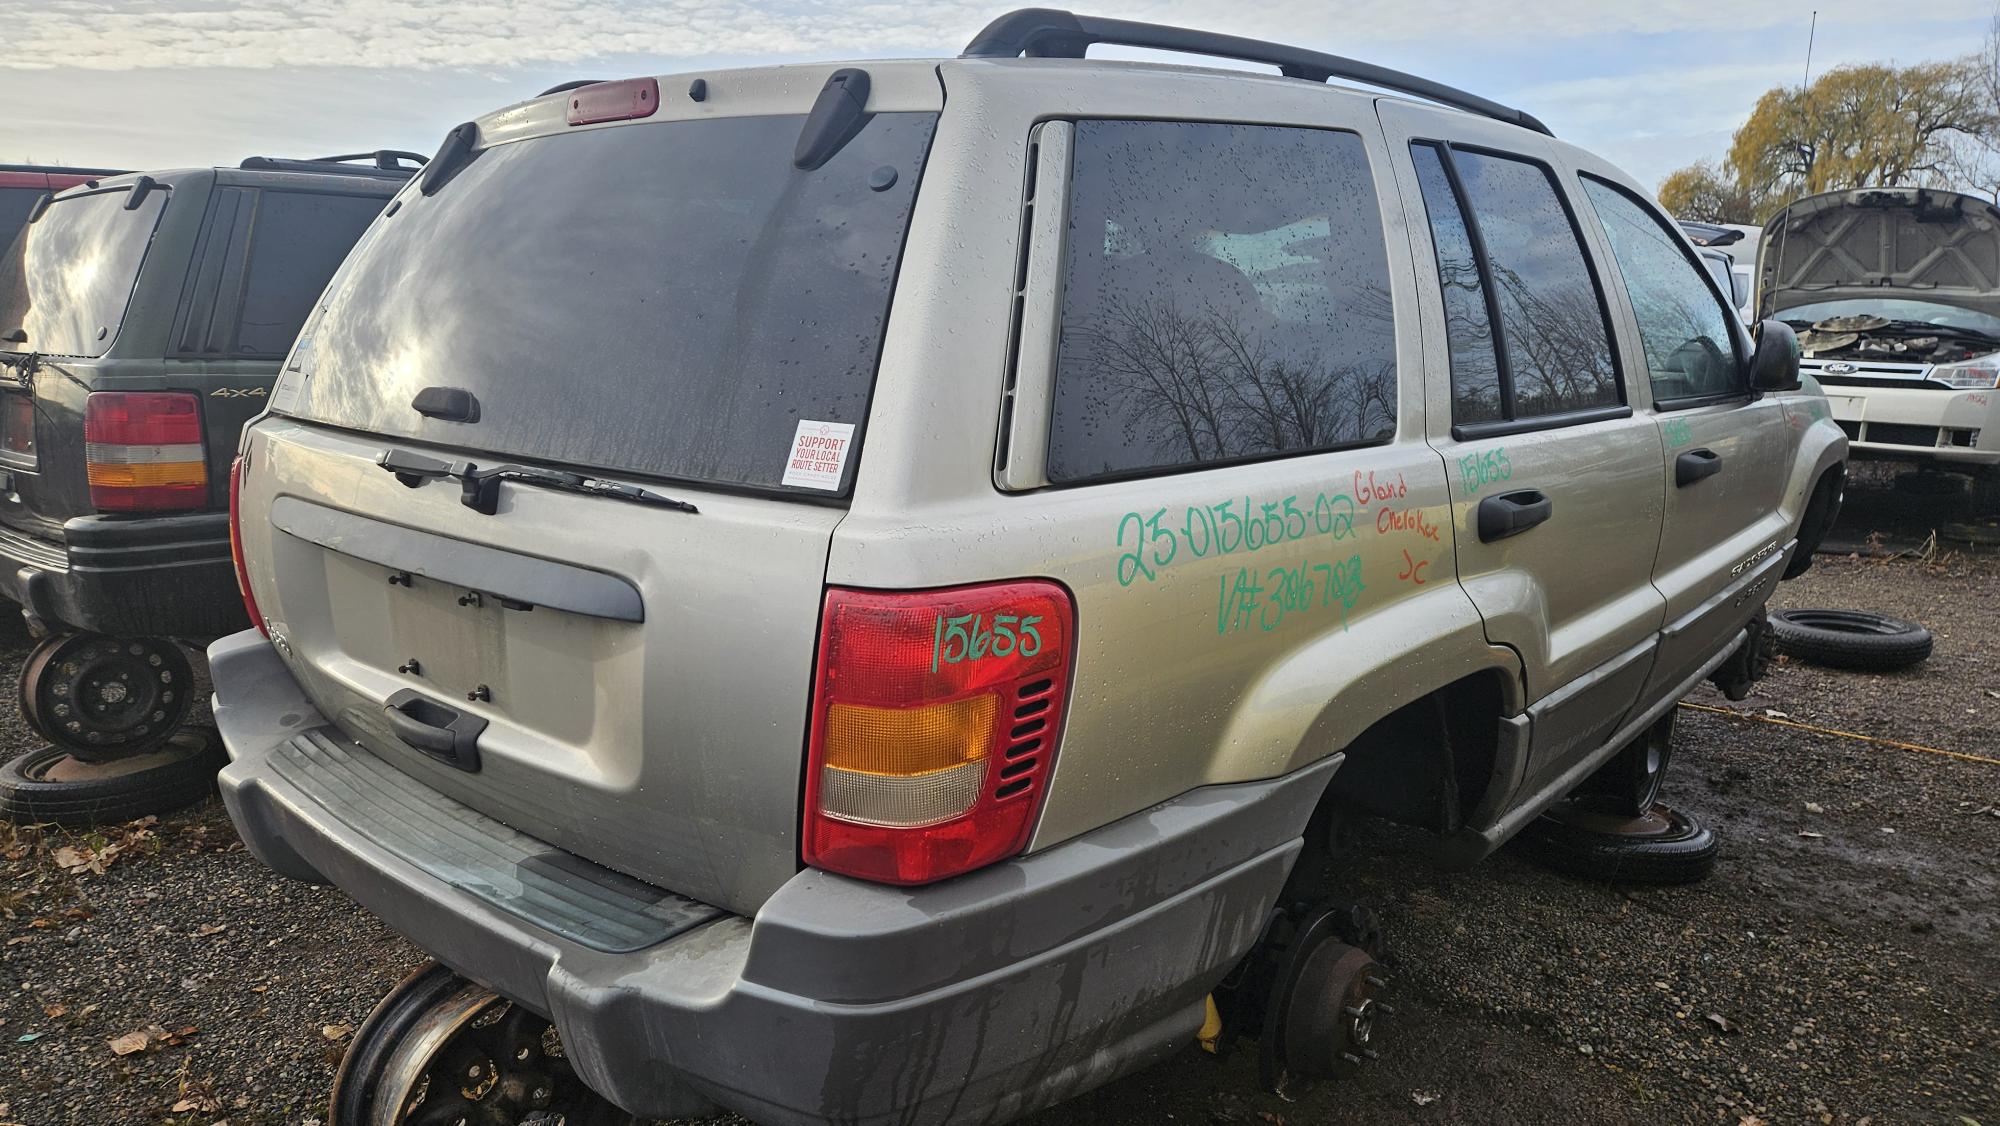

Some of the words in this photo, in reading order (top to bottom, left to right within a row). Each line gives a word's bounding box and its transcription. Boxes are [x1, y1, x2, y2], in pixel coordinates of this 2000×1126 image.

[798, 436, 845, 450] SUPPORT
[796, 448, 815, 459] YOUR
[816, 451, 840, 462] LOCAL
[791, 459, 812, 470] ROUTE
[814, 462, 838, 473] SETTER
[931, 613, 1043, 673] 15655
